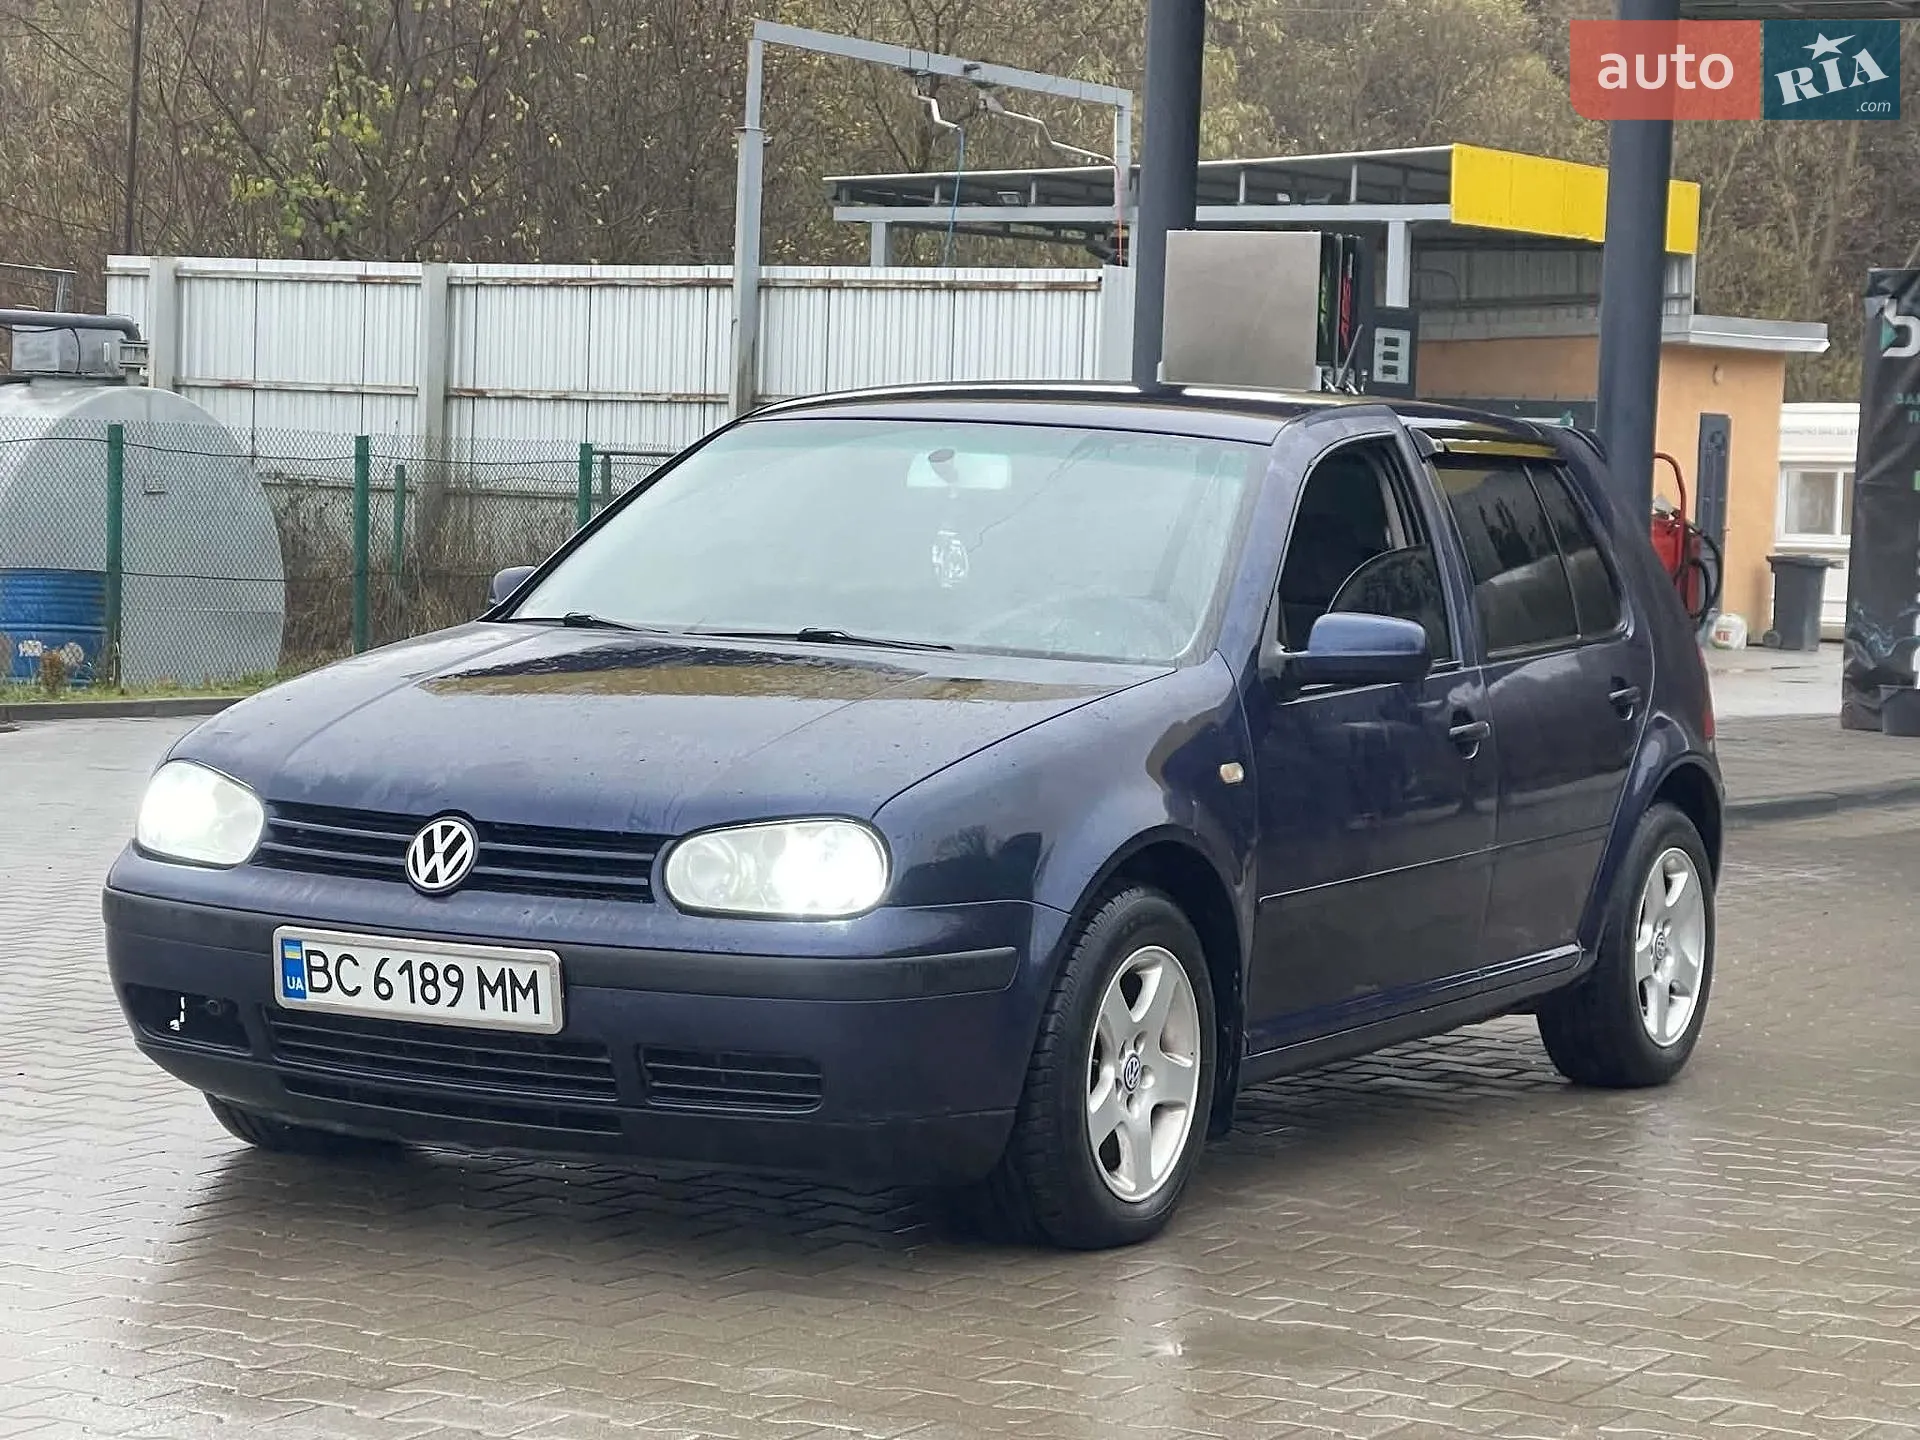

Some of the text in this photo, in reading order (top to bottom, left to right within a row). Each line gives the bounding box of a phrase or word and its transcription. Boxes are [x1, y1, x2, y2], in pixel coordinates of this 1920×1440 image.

[286, 975, 305, 991] UA
[305, 949, 541, 1015] BC 6189 MM
